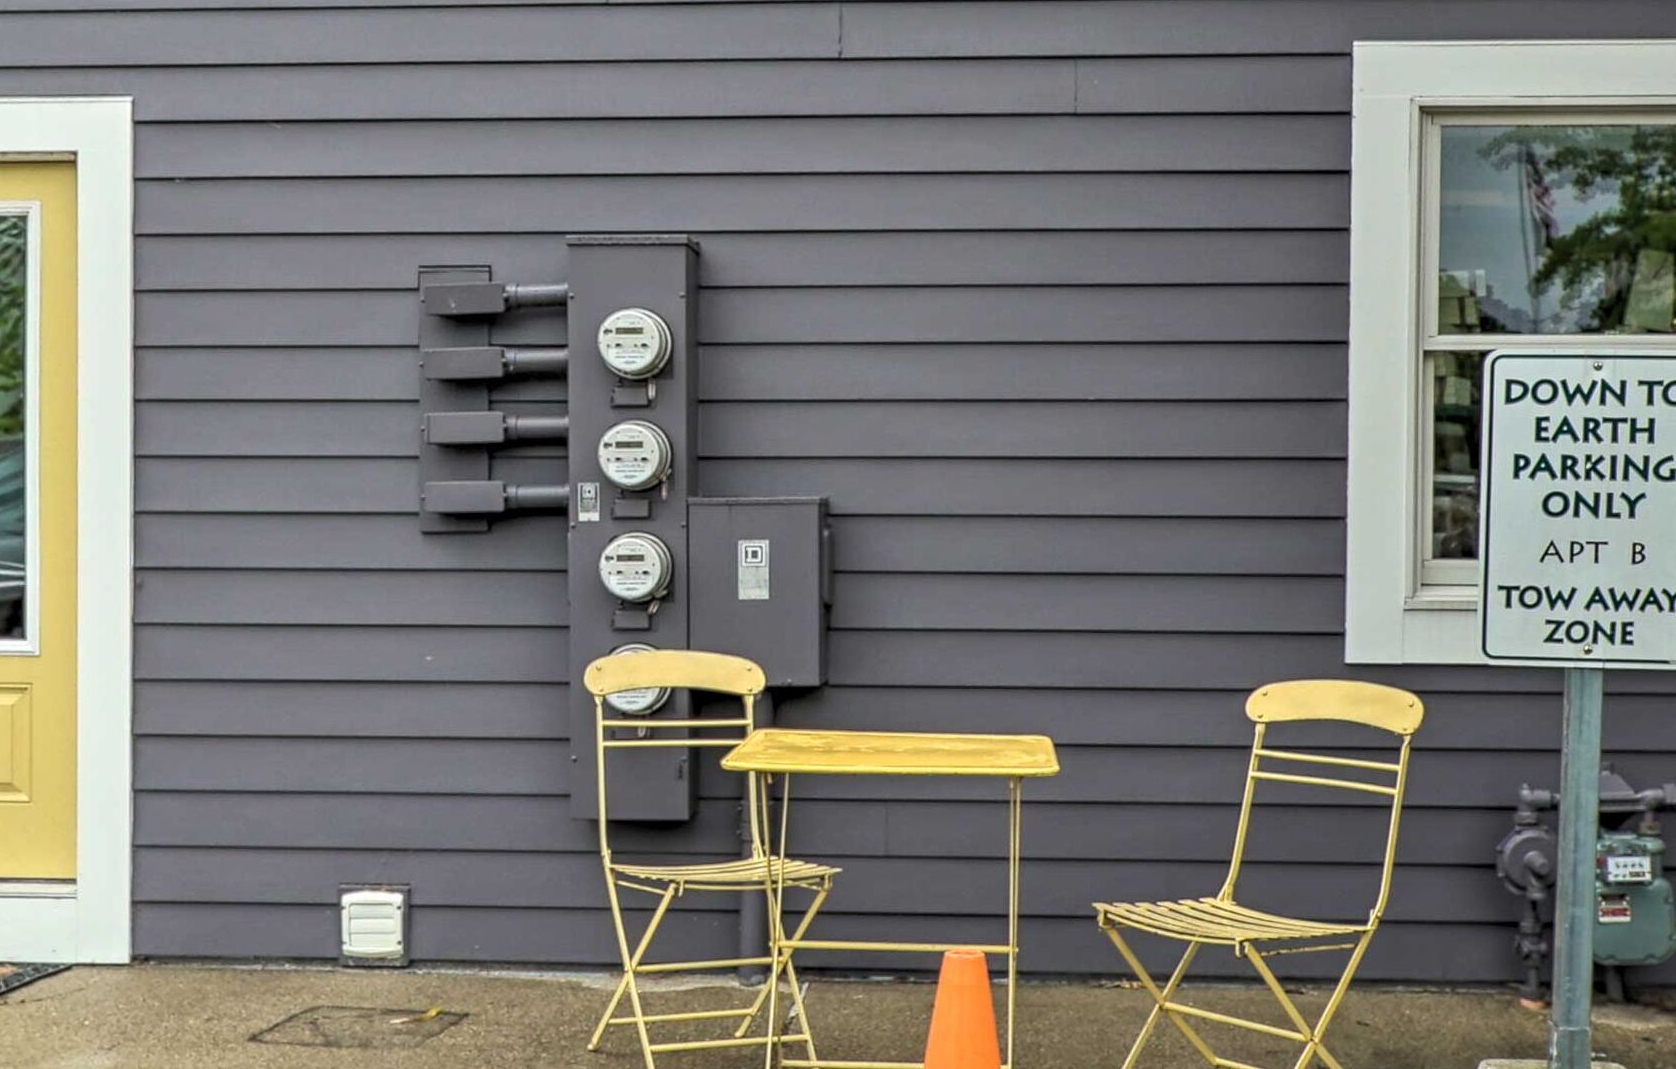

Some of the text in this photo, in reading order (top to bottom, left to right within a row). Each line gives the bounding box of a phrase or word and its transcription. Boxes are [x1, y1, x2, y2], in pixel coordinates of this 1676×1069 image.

[1505, 379, 1627, 407] DOWN
[1535, 416, 1655, 444] EARTH
[1513, 453, 1676, 482] PARKING
[1542, 491, 1646, 519] ONLY
[1540, 540, 1646, 565] APT B
[1497, 585, 1676, 613] TOW AWAY
[1543, 620, 1634, 645] ZONE
